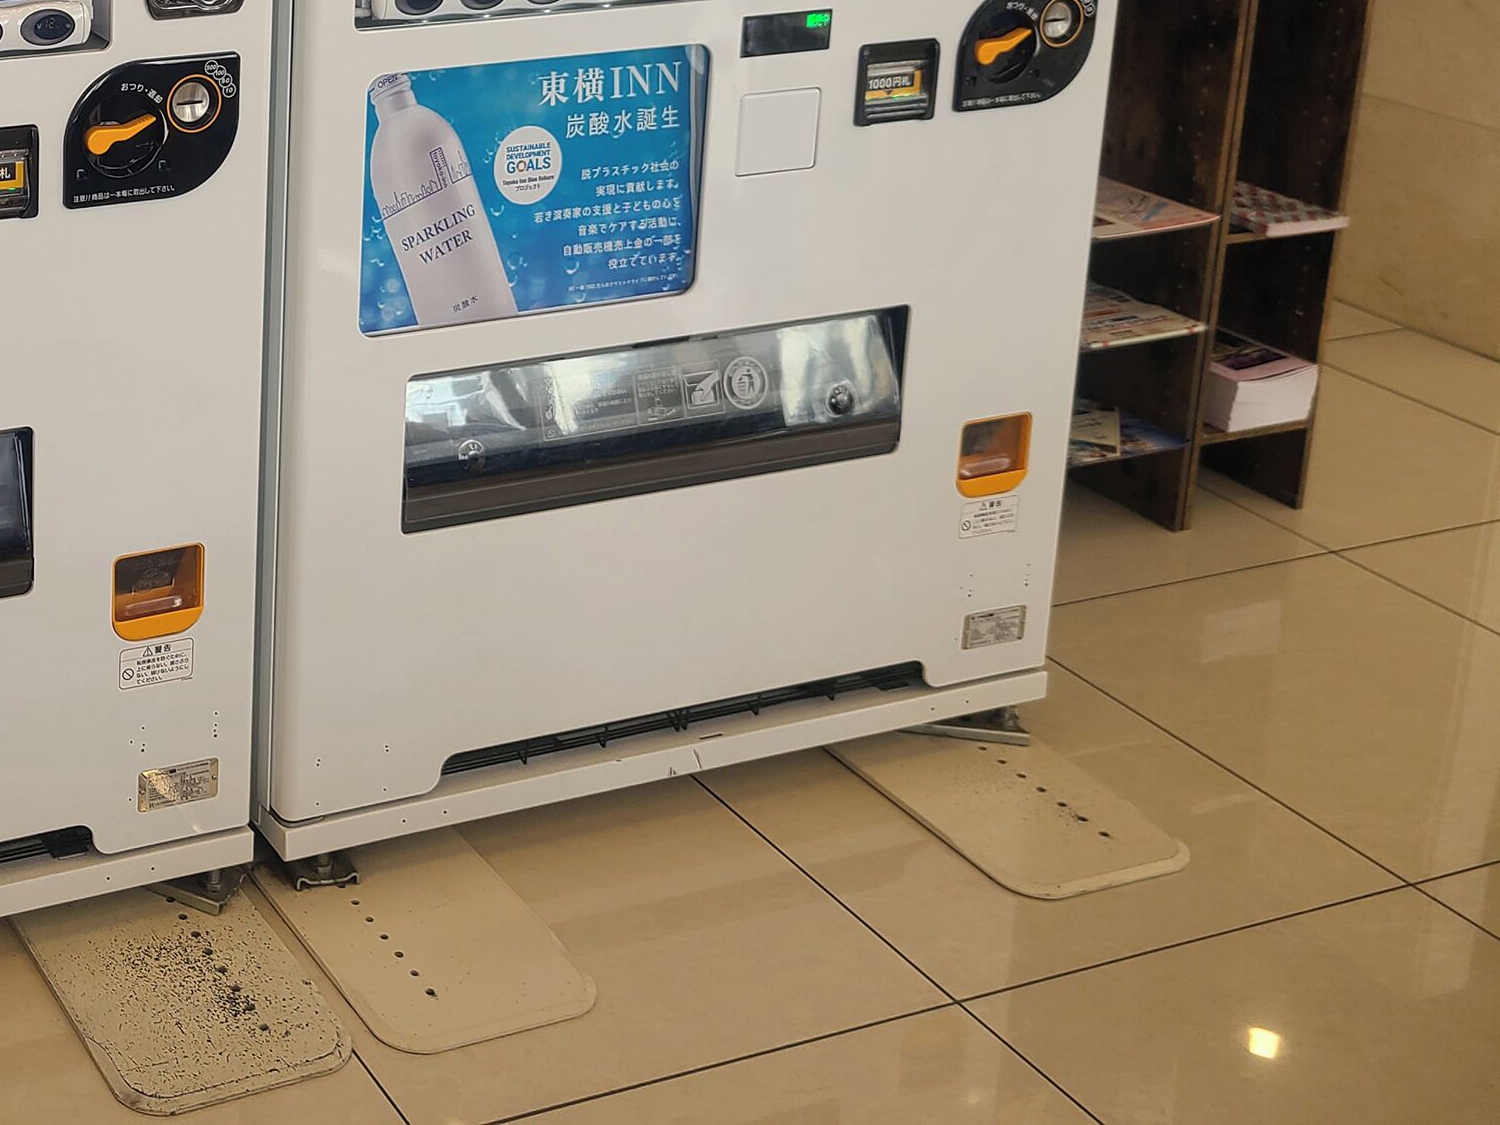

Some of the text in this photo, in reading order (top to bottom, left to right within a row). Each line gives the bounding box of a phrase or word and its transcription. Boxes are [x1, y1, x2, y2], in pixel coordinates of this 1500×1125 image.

[377, 73, 399, 89] OPEN
[536, 60, 683, 108] 東横INN
[564, 106, 680, 140] 炭酸水誕生
[506, 157, 551, 175] GOALS
[400, 203, 476, 252] SPARKLING
[418, 228, 474, 266] WATER
[452, 294, 479, 313] 炭酸水
